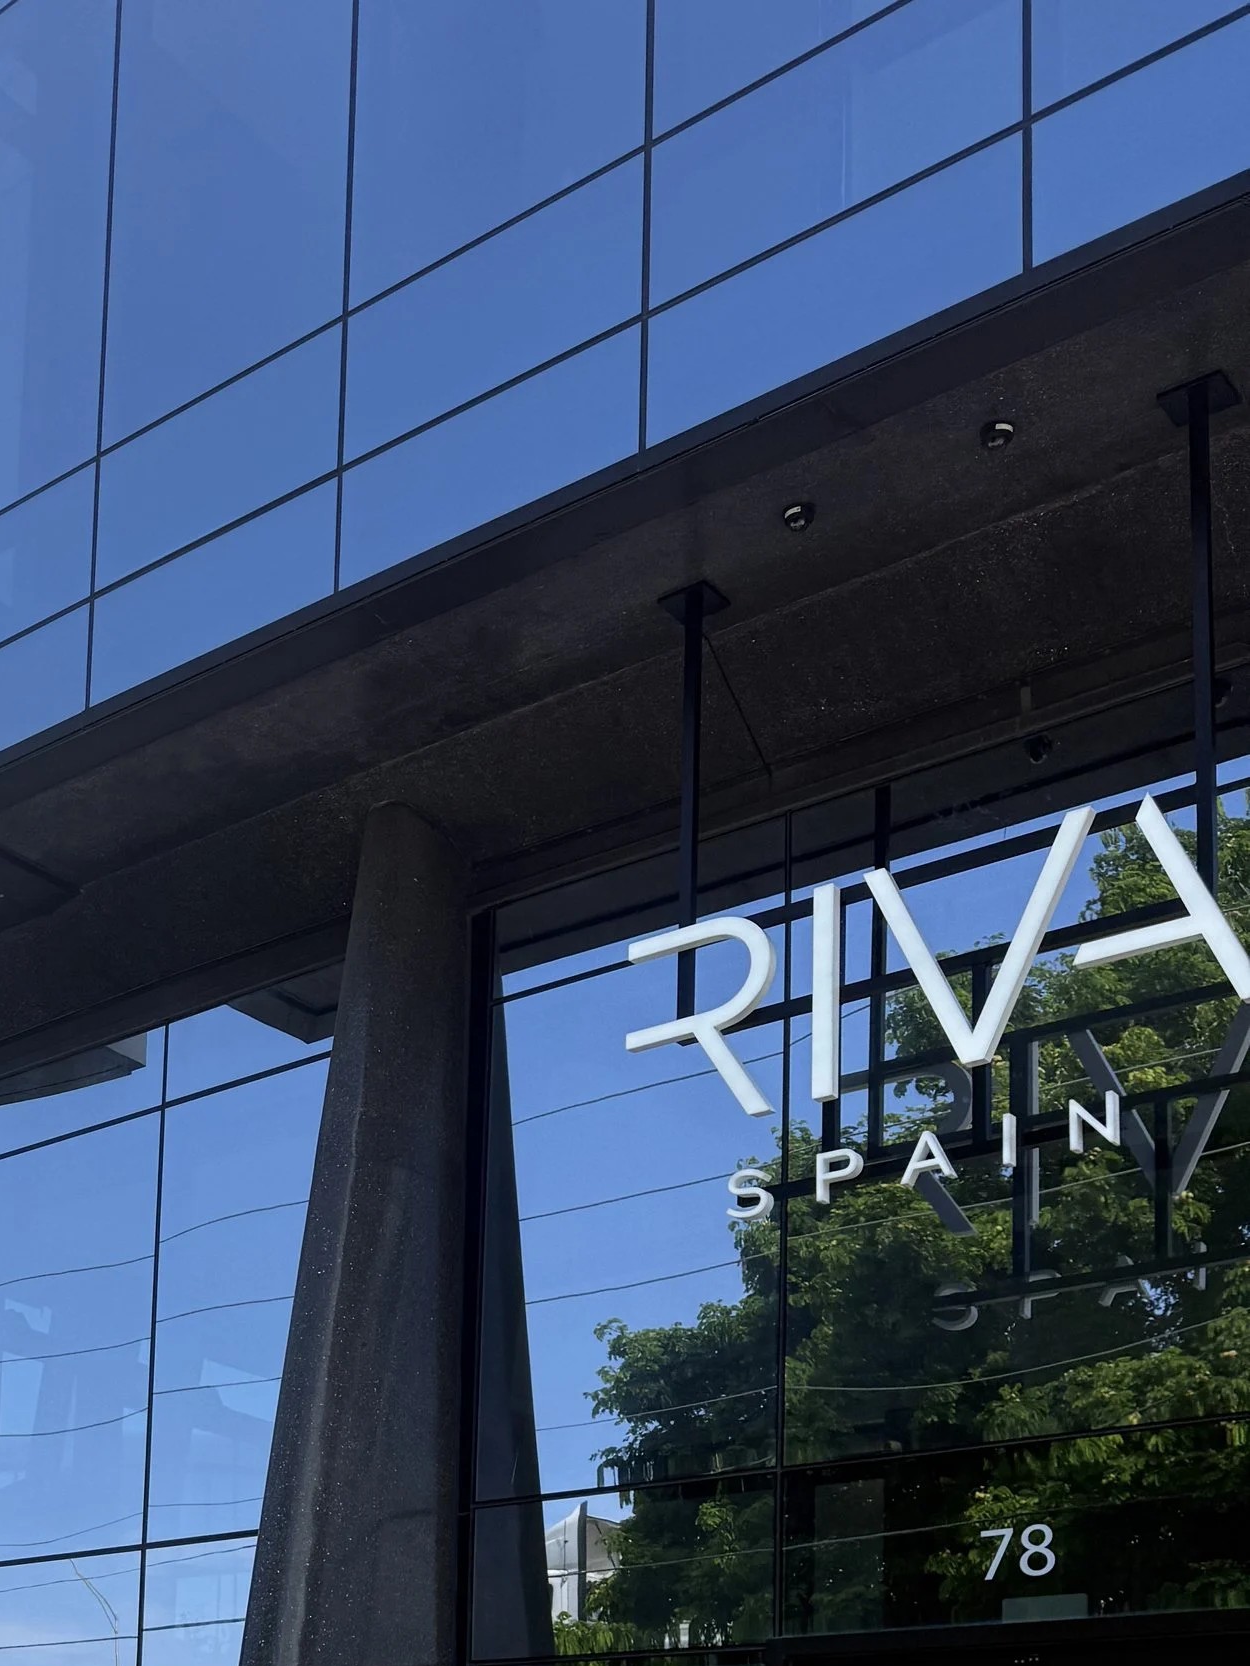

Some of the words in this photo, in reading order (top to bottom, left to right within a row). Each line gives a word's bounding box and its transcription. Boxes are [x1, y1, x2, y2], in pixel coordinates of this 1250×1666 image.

[626, 792, 1250, 1118] RIVA
[726, 1089, 1121, 1221] SPAIN
[980, 1523, 1056, 1581] 78
